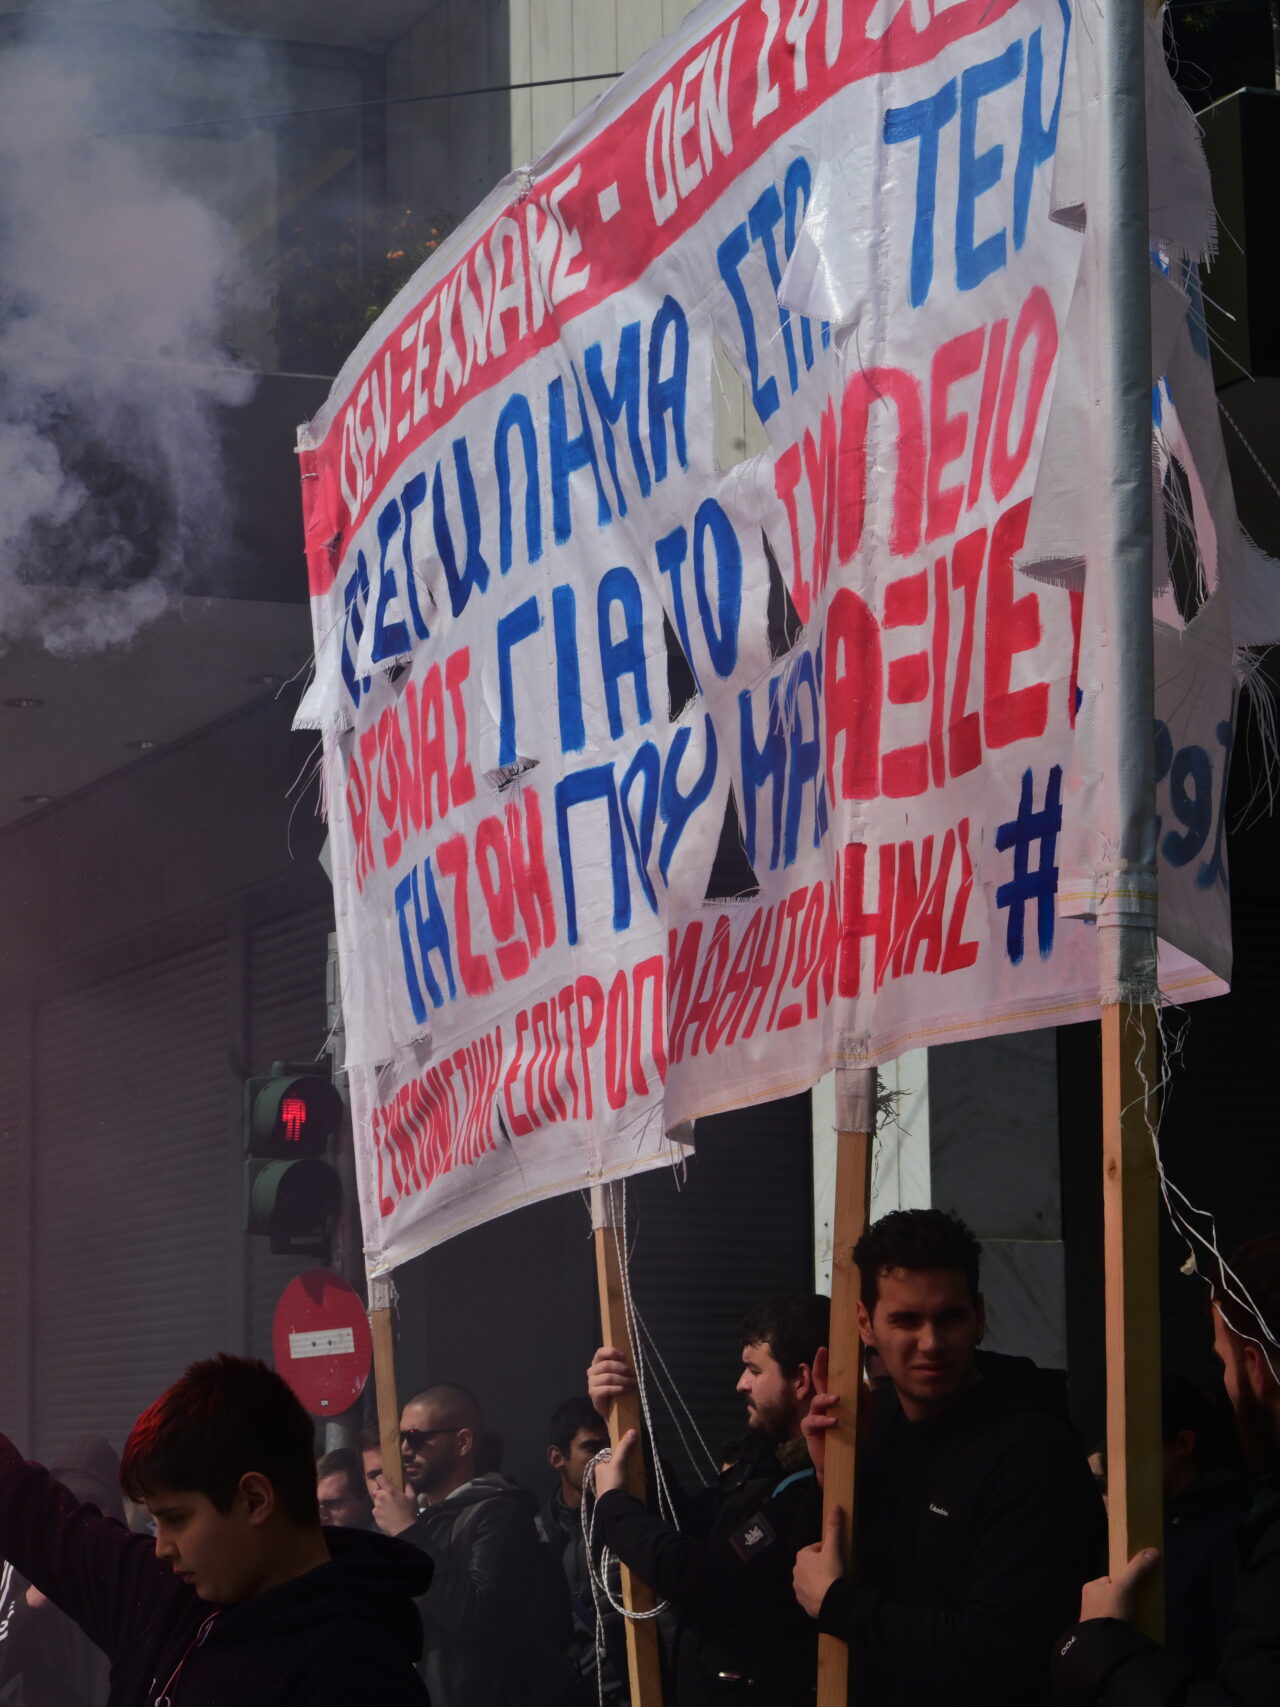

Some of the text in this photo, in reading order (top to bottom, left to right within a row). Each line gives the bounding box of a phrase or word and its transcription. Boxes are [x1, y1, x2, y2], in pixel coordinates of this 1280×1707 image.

[497, 566, 652, 767] ΓΙΑ
[655, 498, 742, 696] ΤΟ
[394, 857, 457, 1025] ΤΗ
[554, 712, 718, 946] ΠΟΥ
